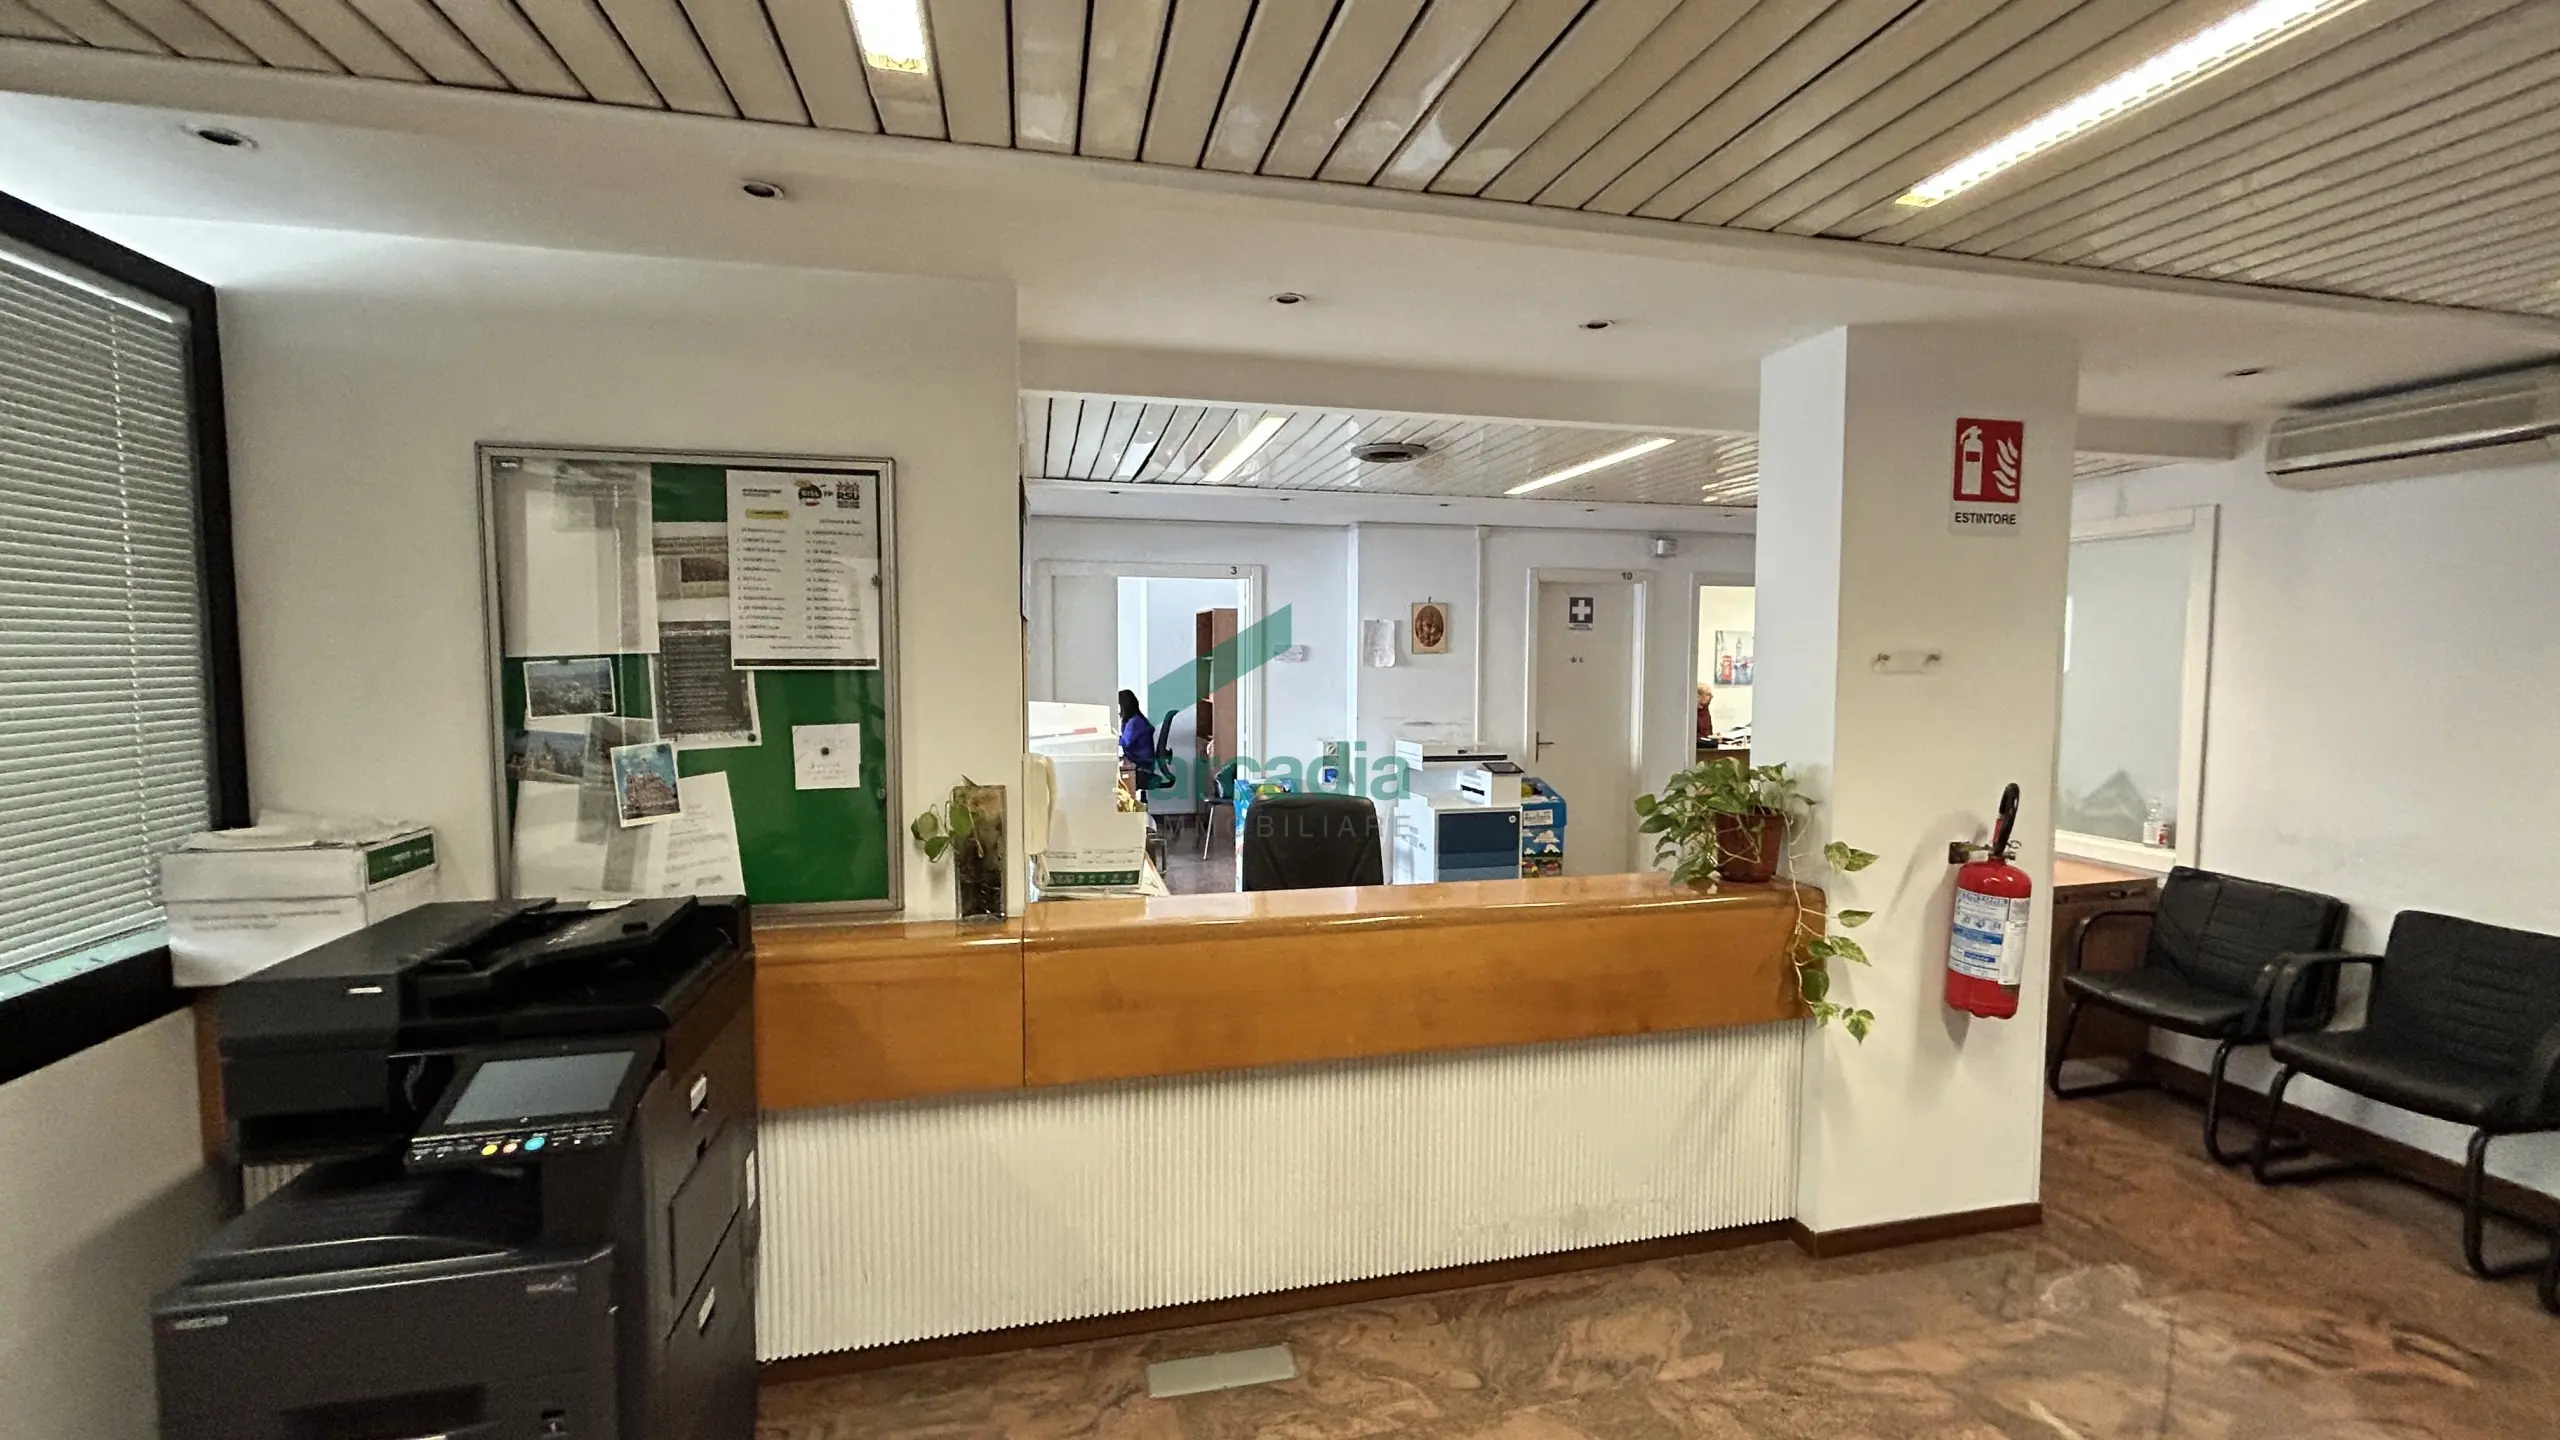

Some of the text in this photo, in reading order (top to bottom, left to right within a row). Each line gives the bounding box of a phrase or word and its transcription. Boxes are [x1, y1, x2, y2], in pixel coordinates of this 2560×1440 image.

[836, 491, 860, 500] RSU
[1955, 512, 2017, 525] ESTINTORE
[1230, 566, 1238, 575] 3
[1621, 572, 1633, 581] 10
